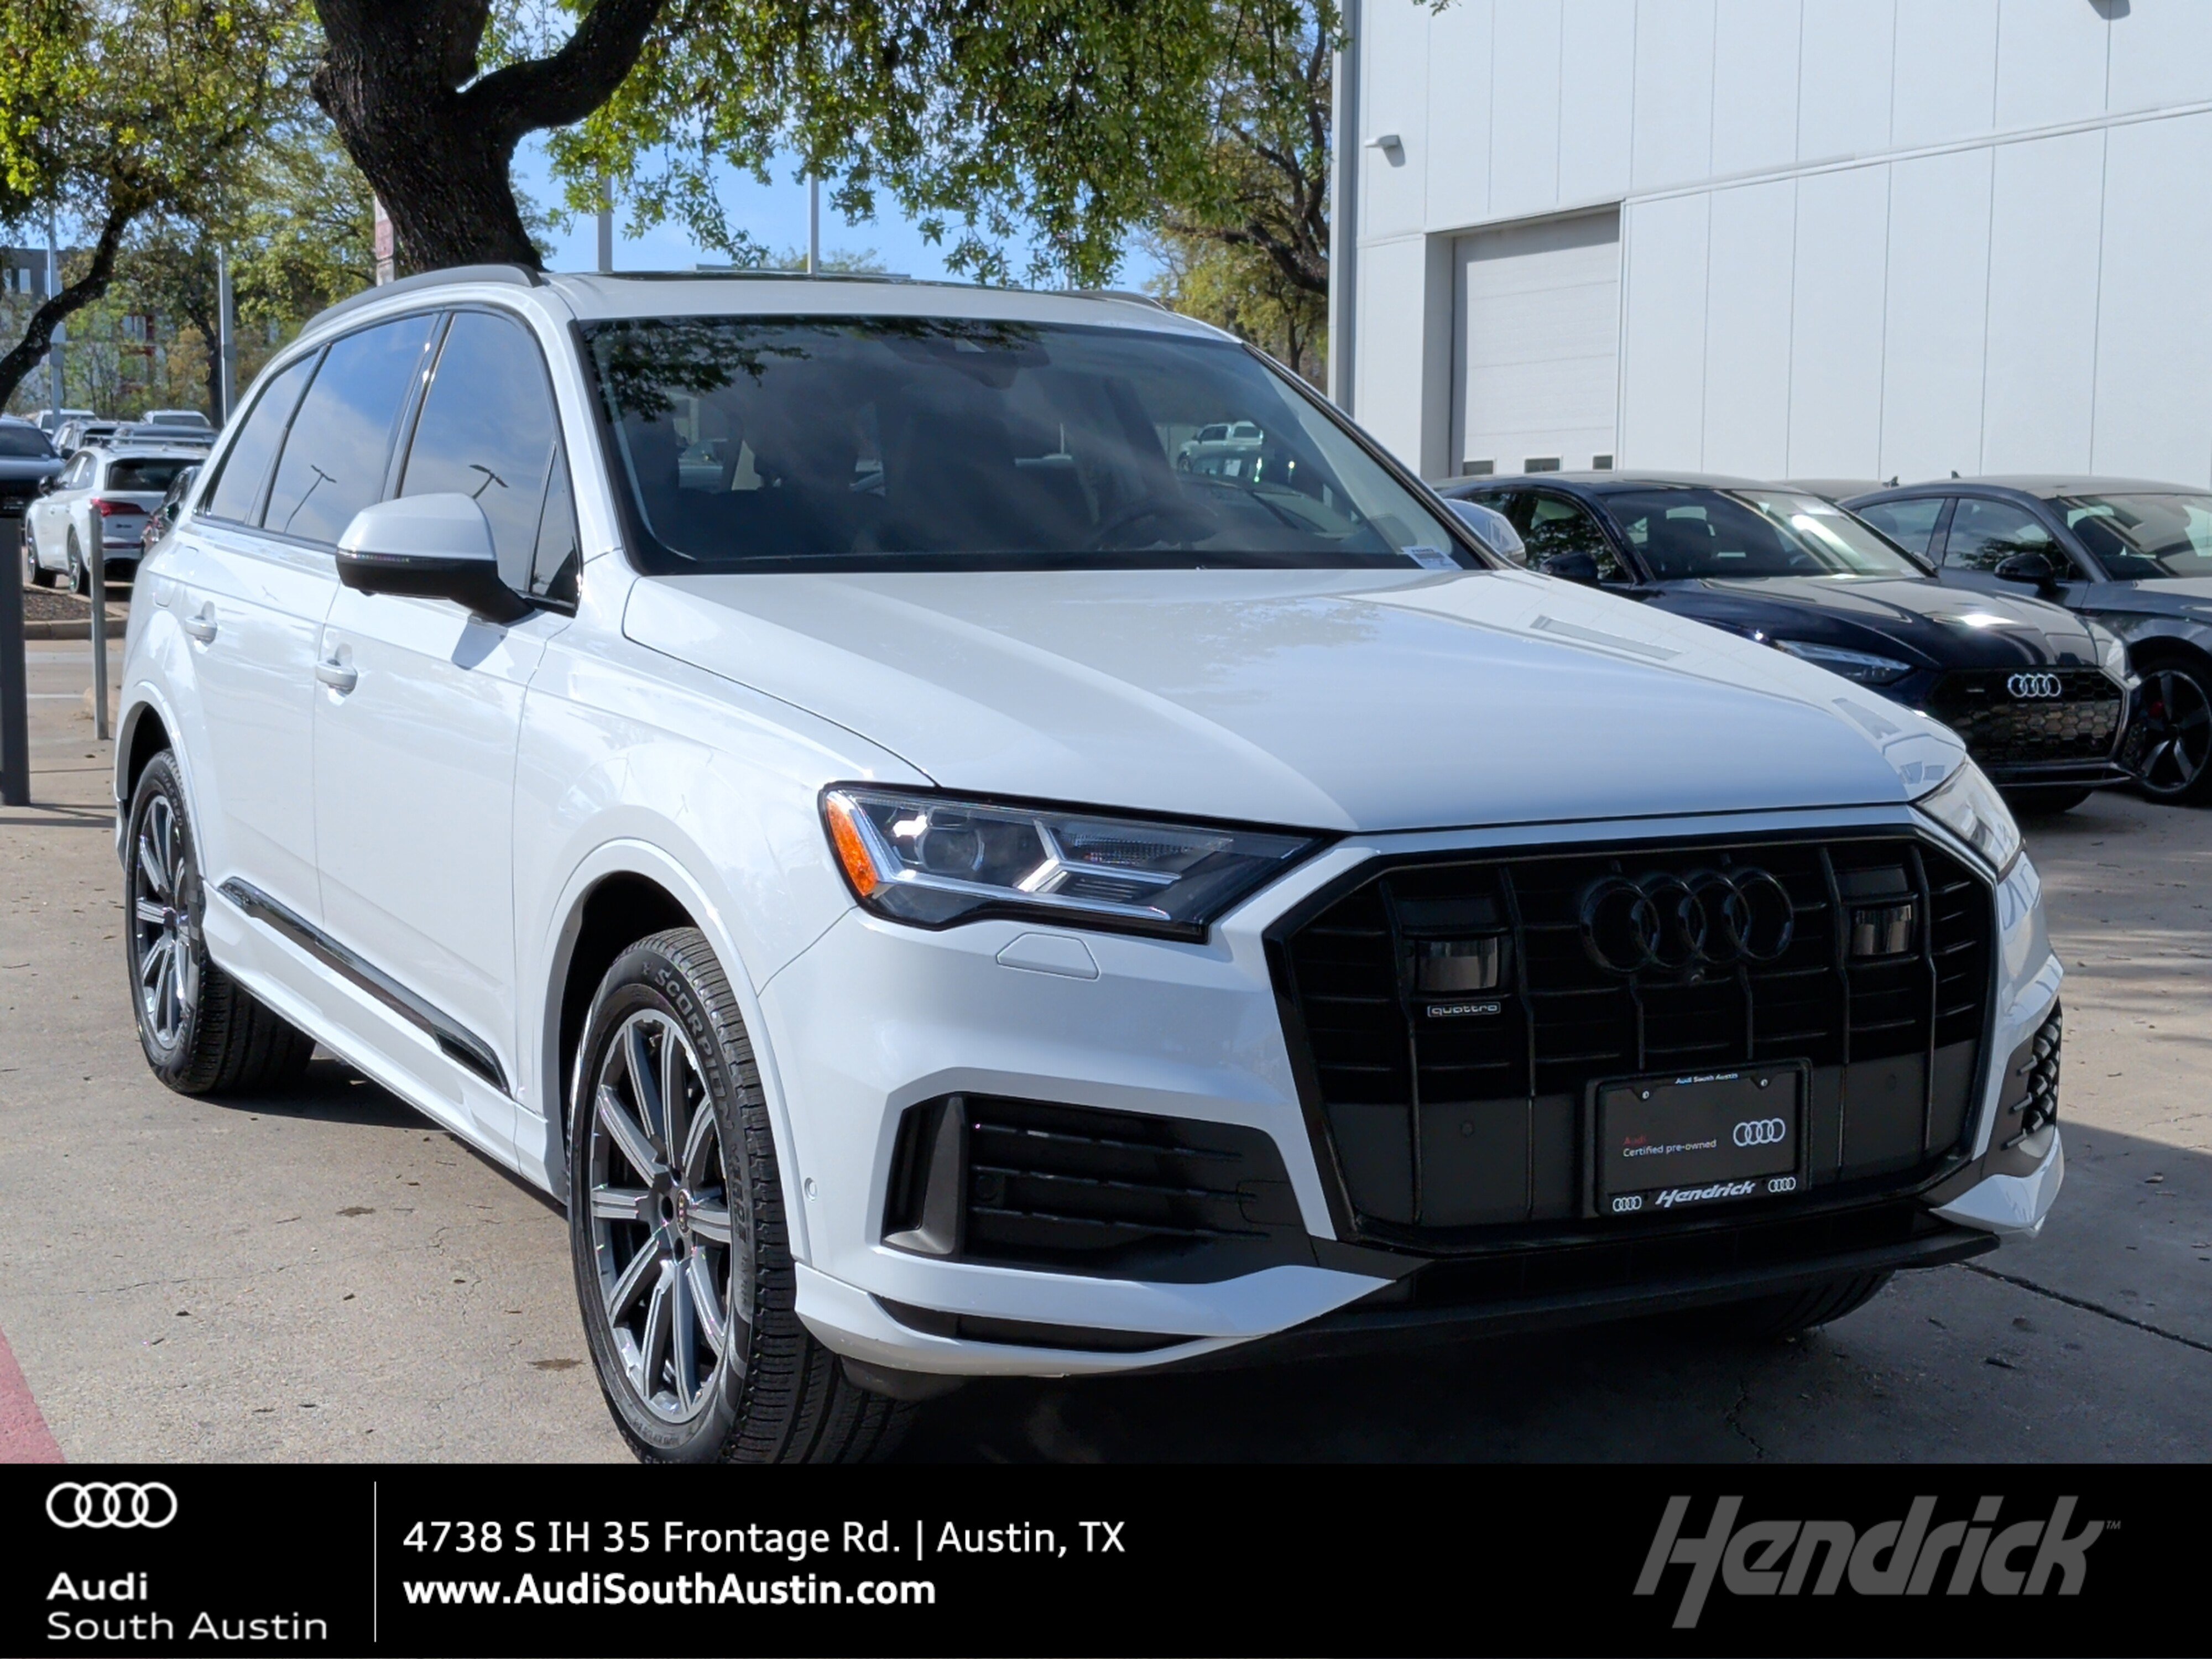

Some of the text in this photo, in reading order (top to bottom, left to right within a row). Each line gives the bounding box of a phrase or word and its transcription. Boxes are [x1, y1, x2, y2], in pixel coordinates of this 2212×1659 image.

[1432, 1005, 1498, 1016] quattro
[655, 968, 734, 1130] SCORPION
[1623, 1139, 1717, 1157] Certified pre-owned
[1655, 1180, 1756, 1208] Hendrick
